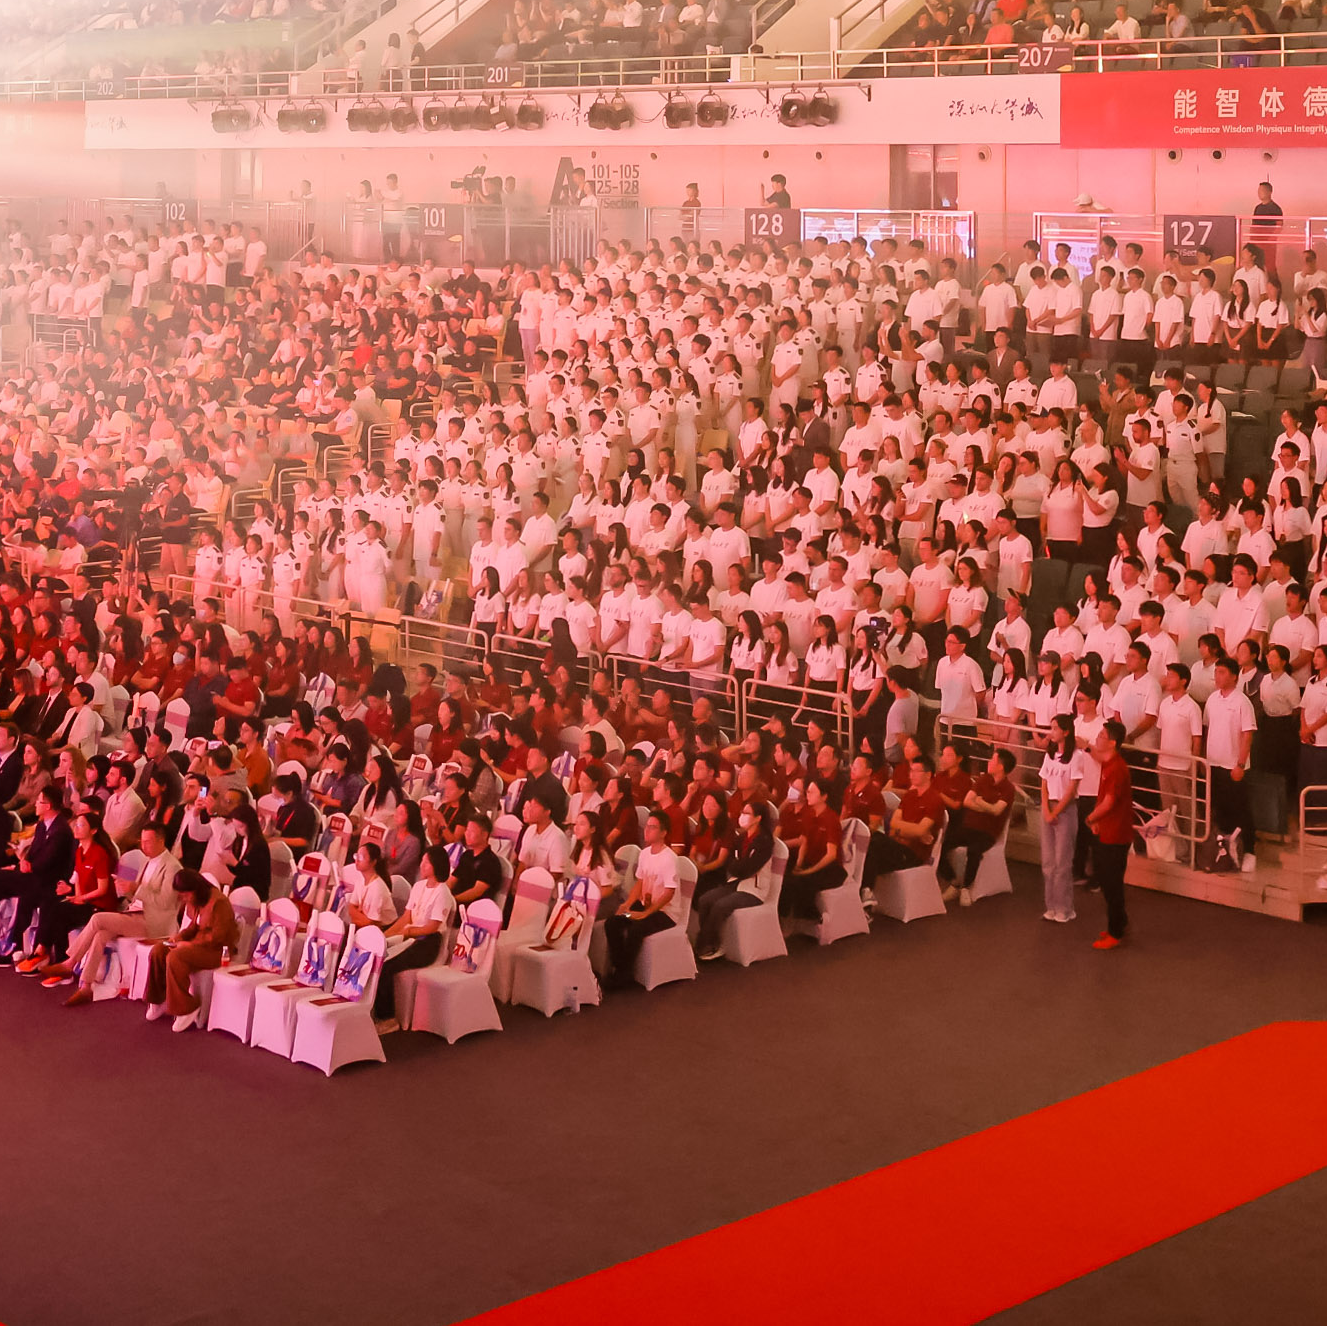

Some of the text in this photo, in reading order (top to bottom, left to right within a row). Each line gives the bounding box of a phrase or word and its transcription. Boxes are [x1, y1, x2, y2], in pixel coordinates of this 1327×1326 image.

[1019, 47, 1053, 66] 207
[487, 66, 508, 83] 201
[97, 82, 114, 95] 202
[1174, 125, 1220, 135] Competence
[1222, 124, 1254, 133] Wisdom
[1256, 124, 1293, 134] Physique
[592, 164, 640, 179] 101-105
[594, 180, 640, 195] 25-128
[165, 203, 186, 220] 102
[424, 208, 445, 227] 101
[750, 213, 783, 235] 128
[1170, 221, 1213, 246] 127
